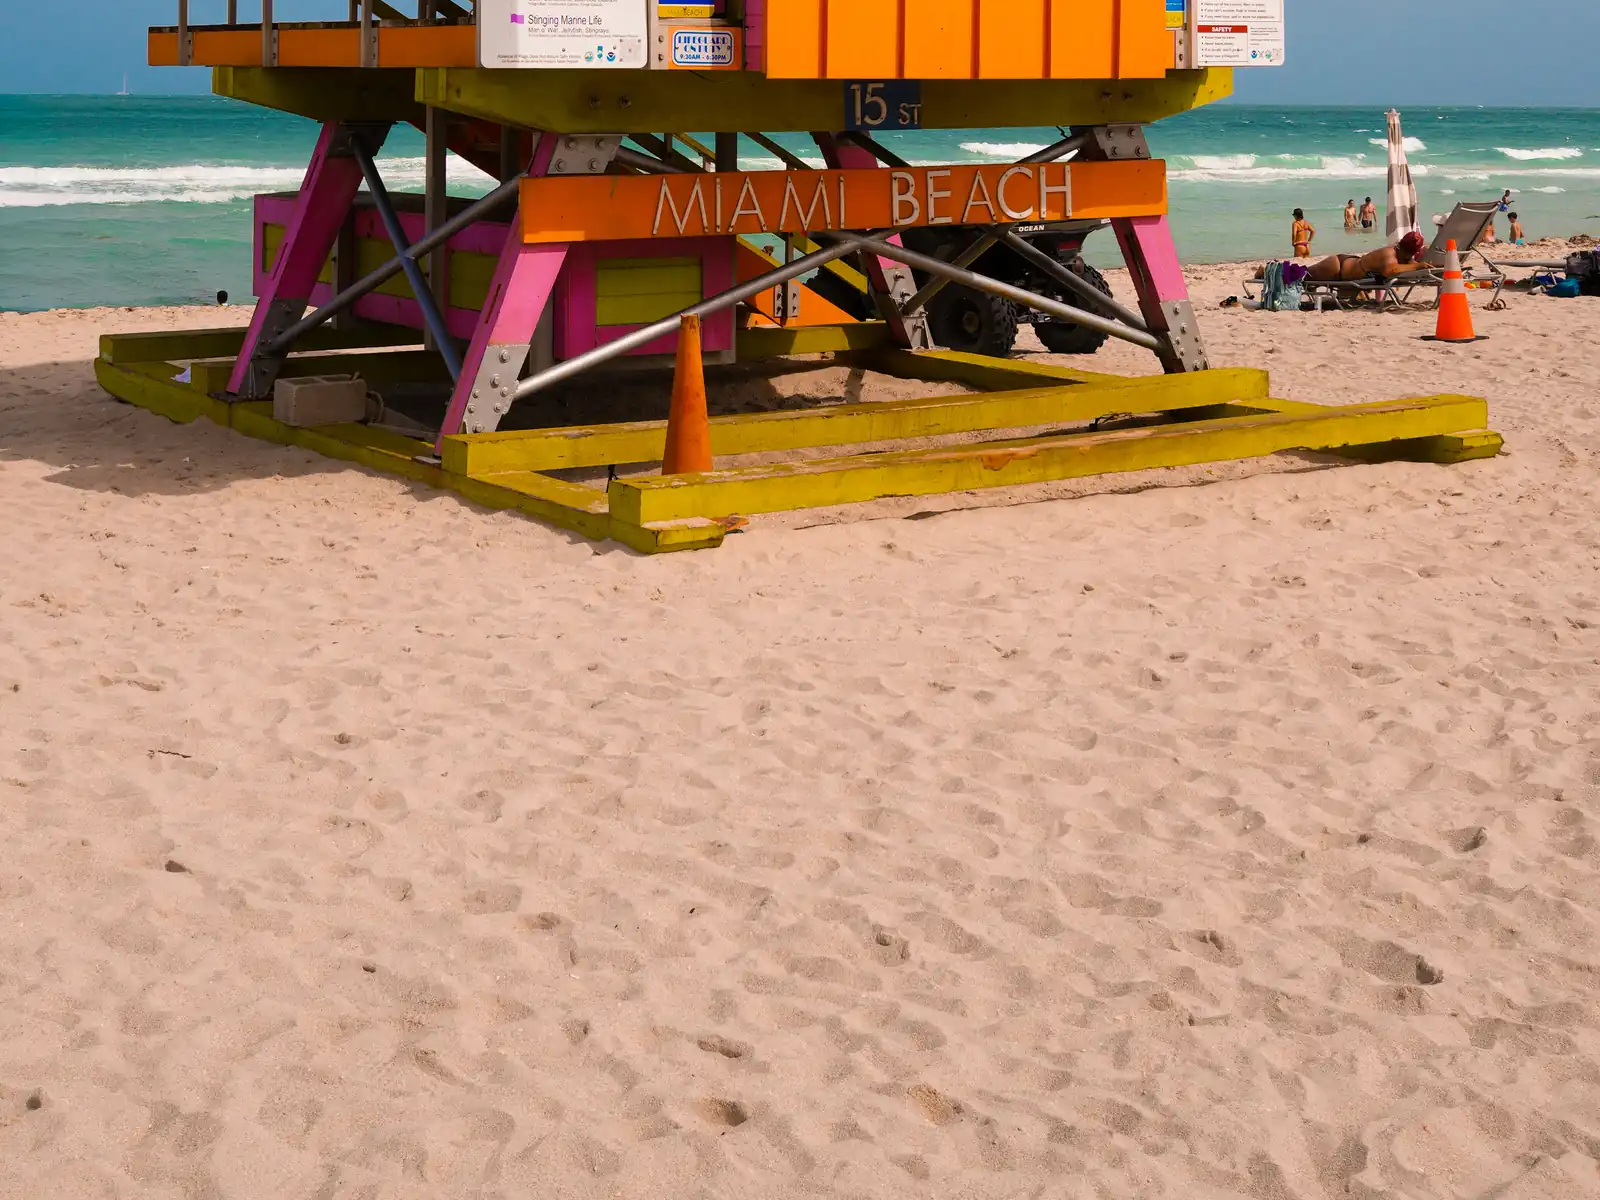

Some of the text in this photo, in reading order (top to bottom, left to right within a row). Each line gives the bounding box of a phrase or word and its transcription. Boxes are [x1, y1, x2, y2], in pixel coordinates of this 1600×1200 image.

[528, 14, 602, 27] Stinging Marine Life
[849, 83, 922, 126] 15 ST
[652, 165, 1073, 235] MIAMI BEACH
[1018, 224, 1045, 232] OCEAN
